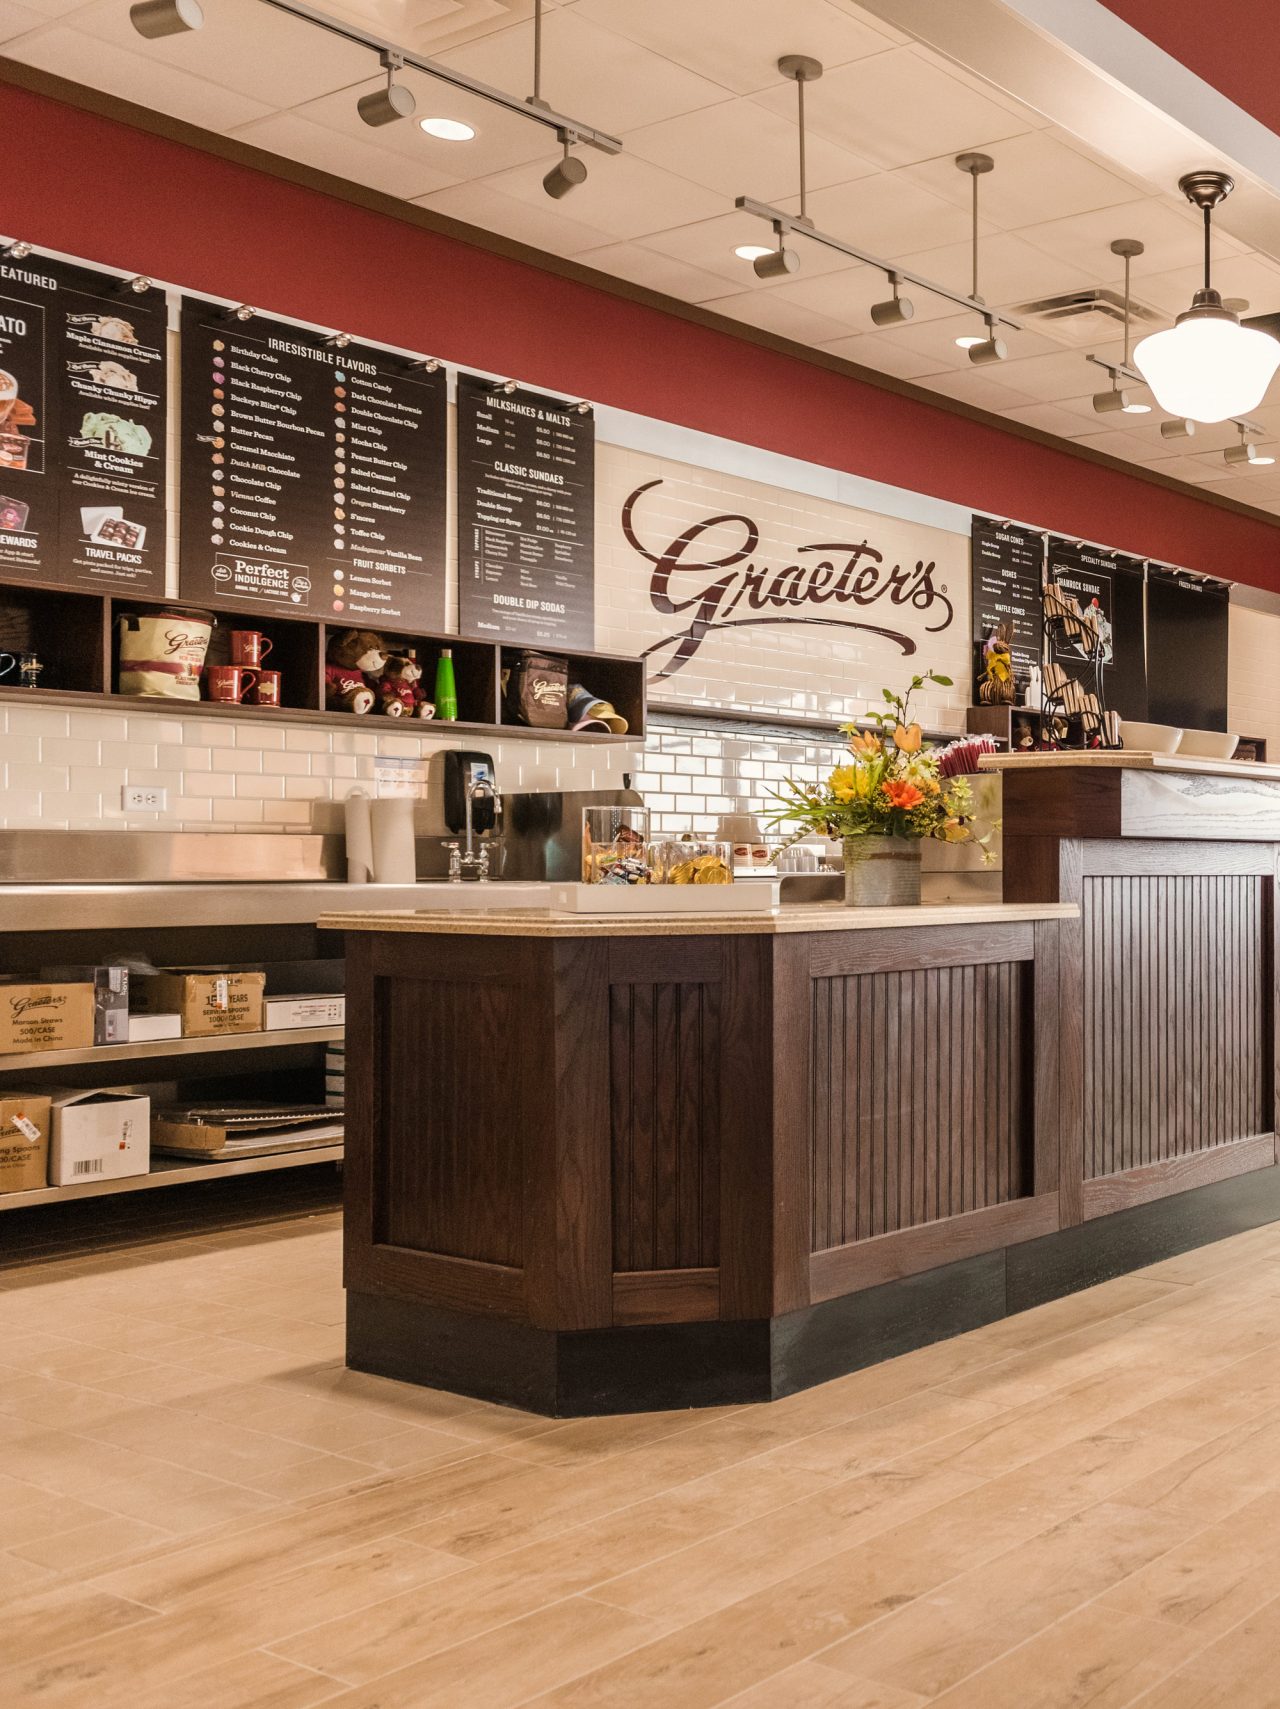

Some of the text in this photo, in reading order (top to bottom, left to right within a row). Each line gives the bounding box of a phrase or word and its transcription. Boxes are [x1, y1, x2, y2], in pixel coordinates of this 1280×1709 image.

[0, 265, 57, 290] EATURED
[66, 331, 91, 343] Maple
[92, 338, 132, 353] Cinnamon
[133, 348, 161, 360] Crunch
[230, 345, 279, 364] Birthday Cake
[268, 337, 377, 376] IRRESISTIBLE FLAVORS
[230, 361, 292, 384] Black Cherry Chip
[71, 380, 102, 393] Chunky
[103, 388, 134, 400] Chunky
[134, 394, 157, 405] Hippo
[230, 377, 302, 402] Black Raspberry Chip
[351, 377, 392, 393] Cotton Candy
[230, 393, 260, 407] Buckeye
[280, 404, 297, 416] Chip
[351, 391, 422, 415] Dark Chocolate Brownie
[486, 396, 571, 427] MILKSHAKES & MALTS
[230, 410, 325, 437] Brown Butter Bourbon Pecan
[351, 406, 418, 430] Double Chocolate Chip
[230, 426, 253, 438] Butter
[253, 430, 274, 442] Pecan
[351, 422, 382, 436] Mint Chip
[230, 442, 295, 462] Caramel Macchiato
[351, 437, 388, 452] Mocha Chip
[84, 450, 143, 468] Mint Cookies
[94, 460, 134, 474] & Cream
[351, 452, 408, 471] Peanut Butter Chip
[230, 458, 251, 468] Dutch
[267, 466, 301, 479] Chocolate
[351, 467, 396, 483] Salted Caramel
[494, 461, 564, 485] CLASSIC SUNDAES
[230, 474, 282, 491] Chocolate Chip
[230, 490, 277, 505] Vienna Coffee
[350, 482, 411, 501] Salted Caramel Chip
[229, 506, 277, 522] Coconut Chip
[372, 502, 406, 515] Strawberry
[229, 523, 294, 541] Cookie Dough Chip
[350, 528, 385, 541] Toffee Chip
[229, 539, 257, 550] Cookies
[264, 544, 287, 555] Cream
[1010, 536, 1024, 546] CONES
[85, 547, 142, 565] TRAVEL PACKS
[1081, 554, 1100, 566] SPECIALTY
[234, 560, 289, 580] Perfect
[353, 558, 406, 575] FRUIT SORBETS
[1002, 569, 1017, 579] DISHES
[234, 574, 289, 589] INDULGENCE
[350, 574, 392, 587] Lemon Sorbet
[1082, 583, 1100, 595] SUNDAE
[350, 588, 392, 601] Mango Sorbet
[349, 603, 380, 614] Raspberry
[381, 607, 401, 617] Sorbet
[493, 594, 565, 614] DOUBLE DIP SODAS
[994, 603, 1026, 616] WAFFLE CONES
[228, 993, 249, 1004] YEARS
[20, 1026, 55, 1035] 500/CASE
